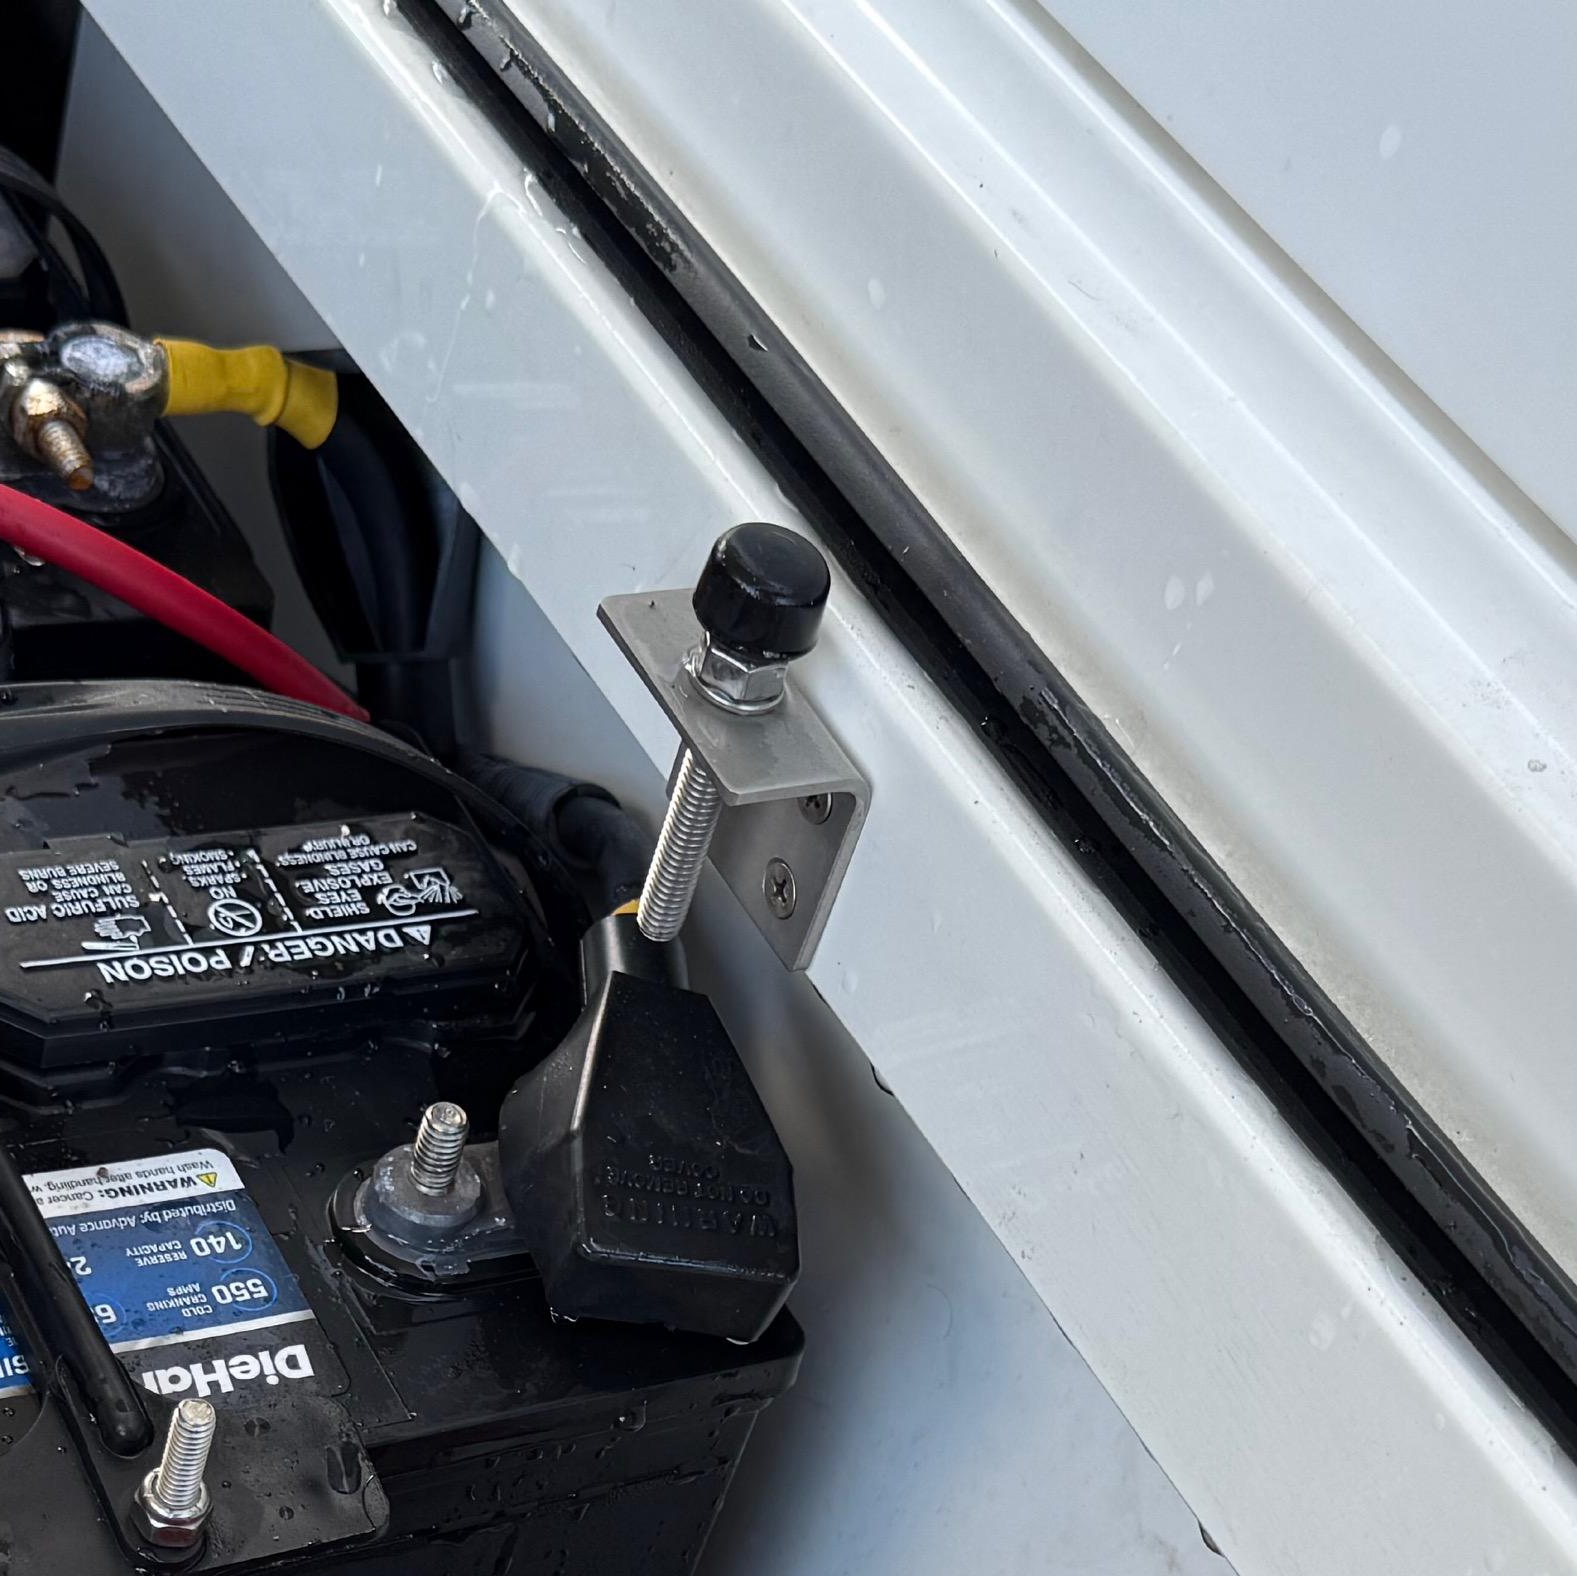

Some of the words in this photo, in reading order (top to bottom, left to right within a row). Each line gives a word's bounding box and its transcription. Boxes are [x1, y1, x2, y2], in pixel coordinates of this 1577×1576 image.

[348, 842, 388, 857] CAUSE
[389, 839, 416, 853] CAN
[276, 846, 346, 865] BLINDNESS
[17, 864, 63, 880] BURNS
[67, 859, 119, 875] SEVERE
[24, 878, 45, 892] OR
[50, 871, 125, 889] BLINDNESS
[51, 886, 97, 901] CAUSE
[99, 882, 131, 897] CAN
[209, 885, 236, 899] NO
[6, 904, 45, 922] ACID
[49, 893, 139, 917] SULFURIC
[265, 926, 403, 962] DANGER
[95, 946, 231, 982] POISON
[135, 1164, 174, 1180] hands
[176, 1159, 213, 1174] Wash
[97, 1174, 196, 1199] WARNING:
[46, 1188, 94, 1206] Cancer
[139, 1209, 160, 1225] by:
[161, 1198, 235, 1222] Distributed
[78, 1213, 136, 1234] Advance
[123, 1239, 181, 1257] CAPACITY
[188, 1229, 242, 1257] 140
[133, 1250, 186, 1267] RESERVE
[165, 1282, 200, 1296] AMPS
[210, 1276, 268, 1305] 550
[145, 1292, 206, 1311] CRANKING
[180, 1303, 212, 1317] COLD
